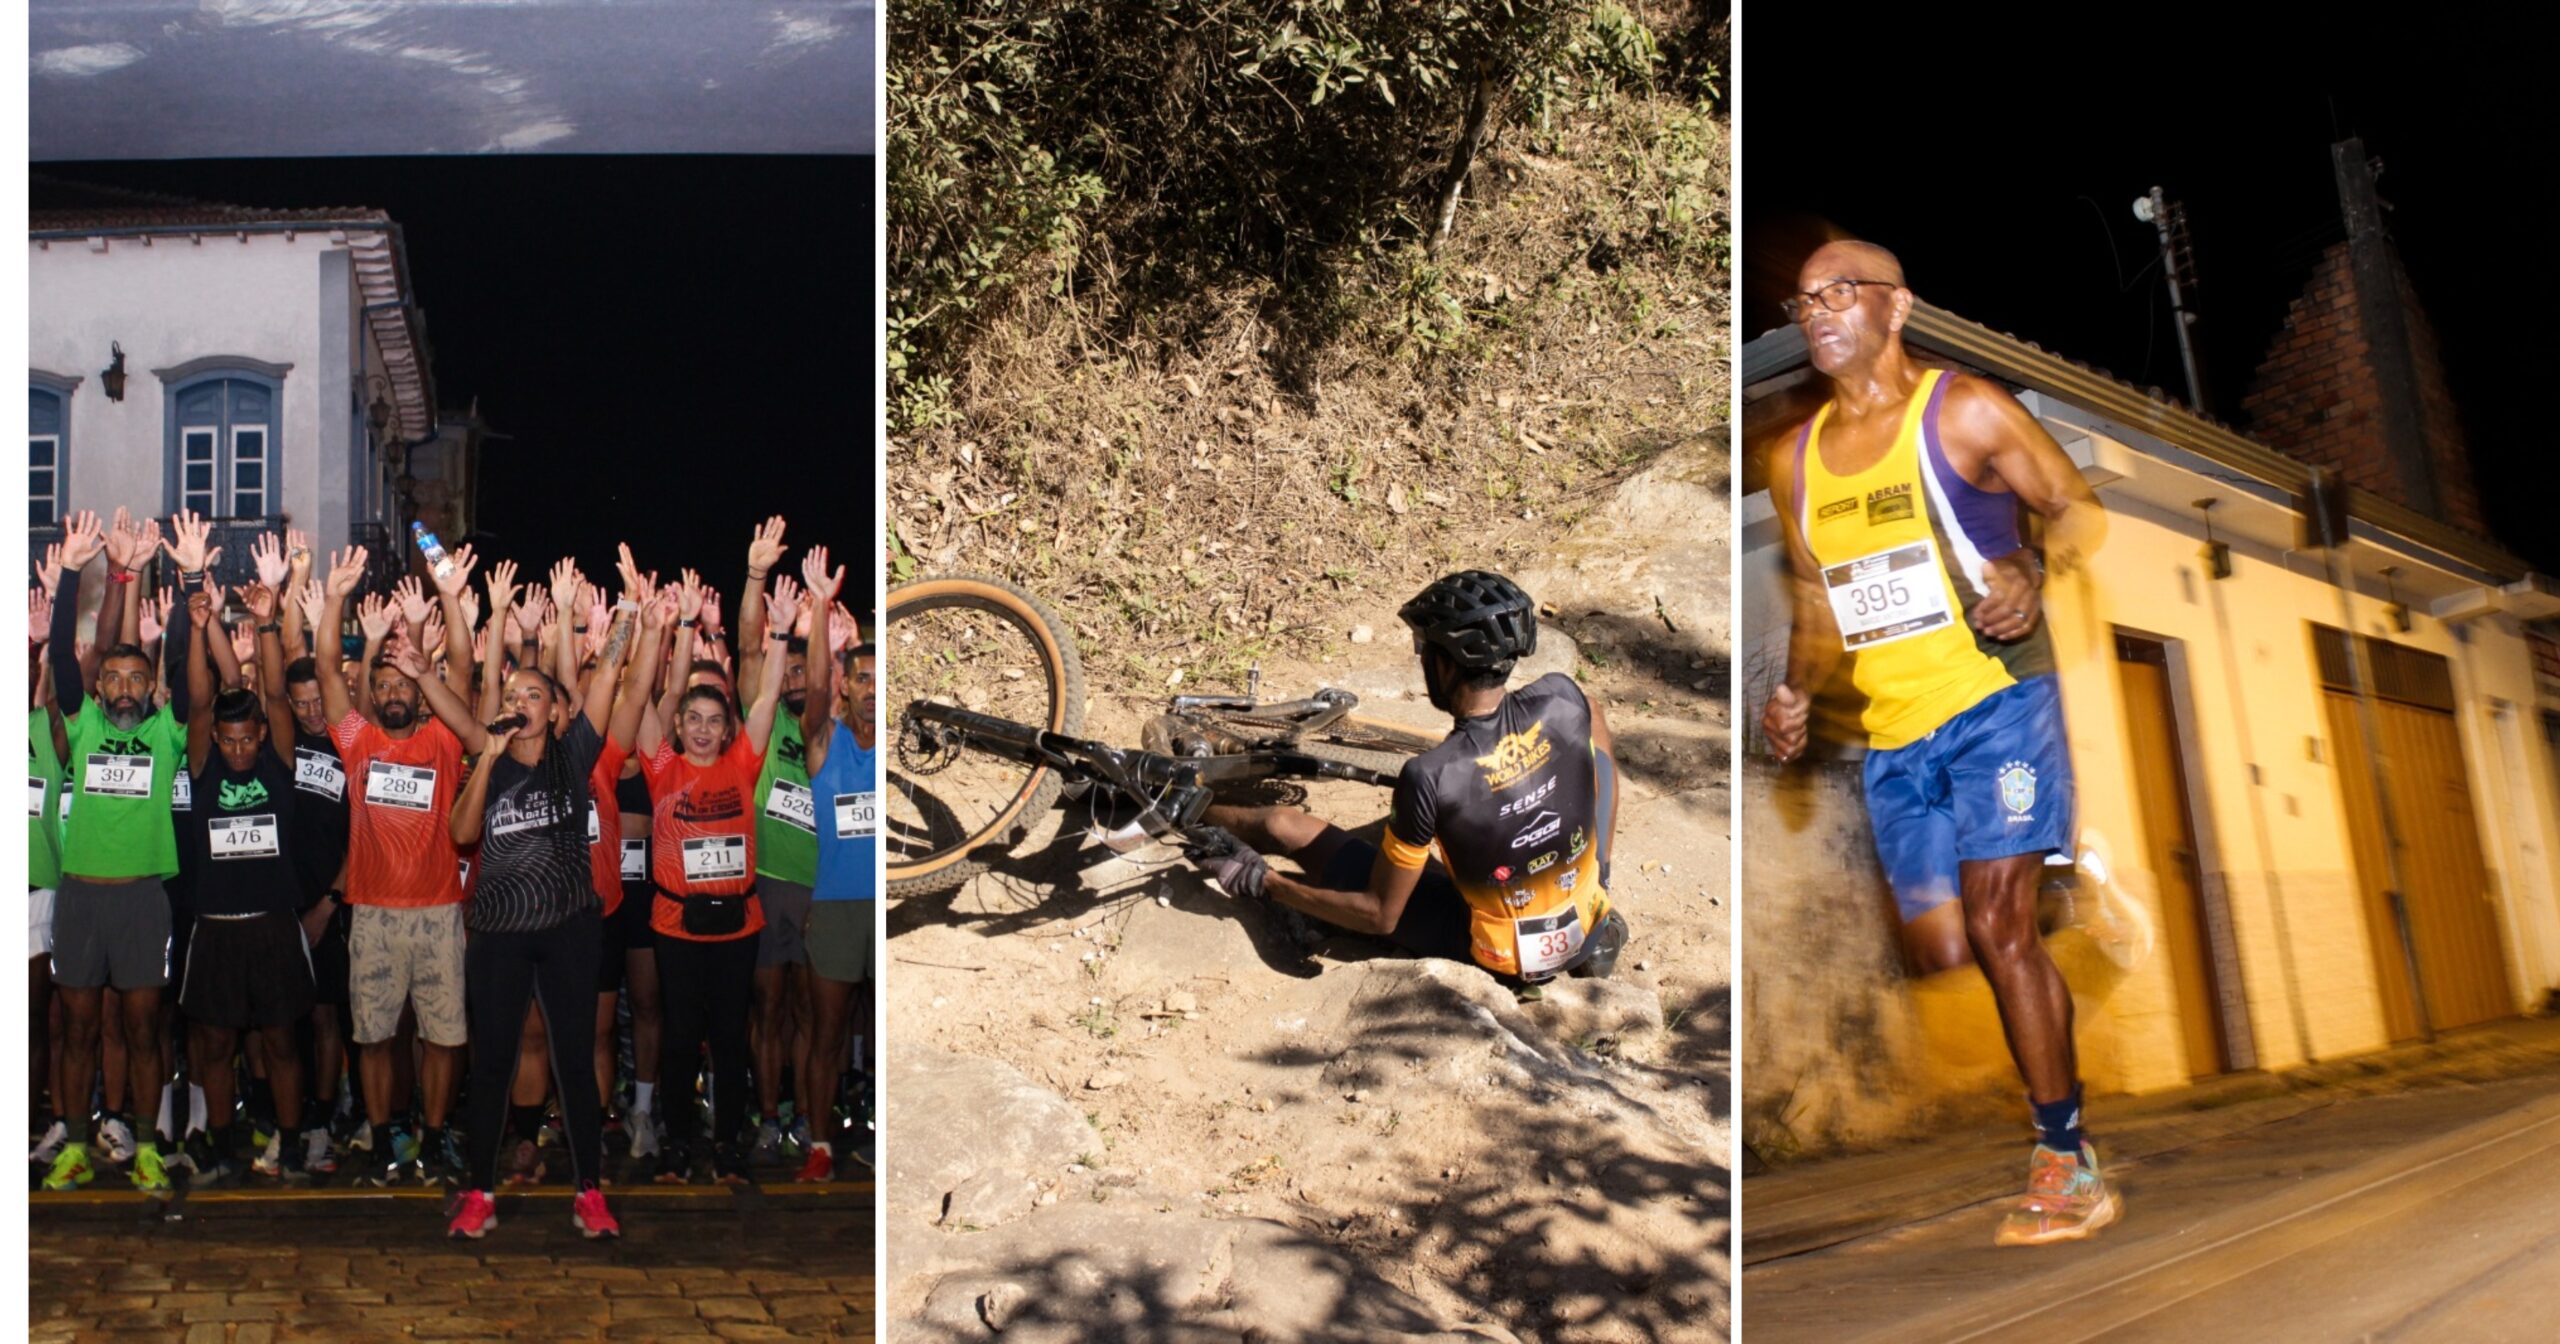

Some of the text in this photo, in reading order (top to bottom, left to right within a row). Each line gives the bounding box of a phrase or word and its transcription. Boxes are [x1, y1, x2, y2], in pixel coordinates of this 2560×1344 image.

[1867, 482, 1912, 503] ABRAM
[1851, 577, 1910, 616] 395
[1484, 763, 1521, 786] WORLD
[1521, 739, 1551, 768] BIKES
[101, 767, 136, 783] 397
[302, 763, 335, 783] 346
[382, 777, 418, 795] 289
[1500, 775, 1557, 817] SENSE
[782, 794, 813, 817] 526
[852, 806, 875, 822] 50
[2007, 814, 2035, 823] BRASIL
[226, 829, 262, 845] 476
[1511, 817, 1561, 849] OGGI
[701, 850, 730, 866] 211
[1528, 854, 1552, 871] PLAY
[1539, 931, 1569, 957] 33
